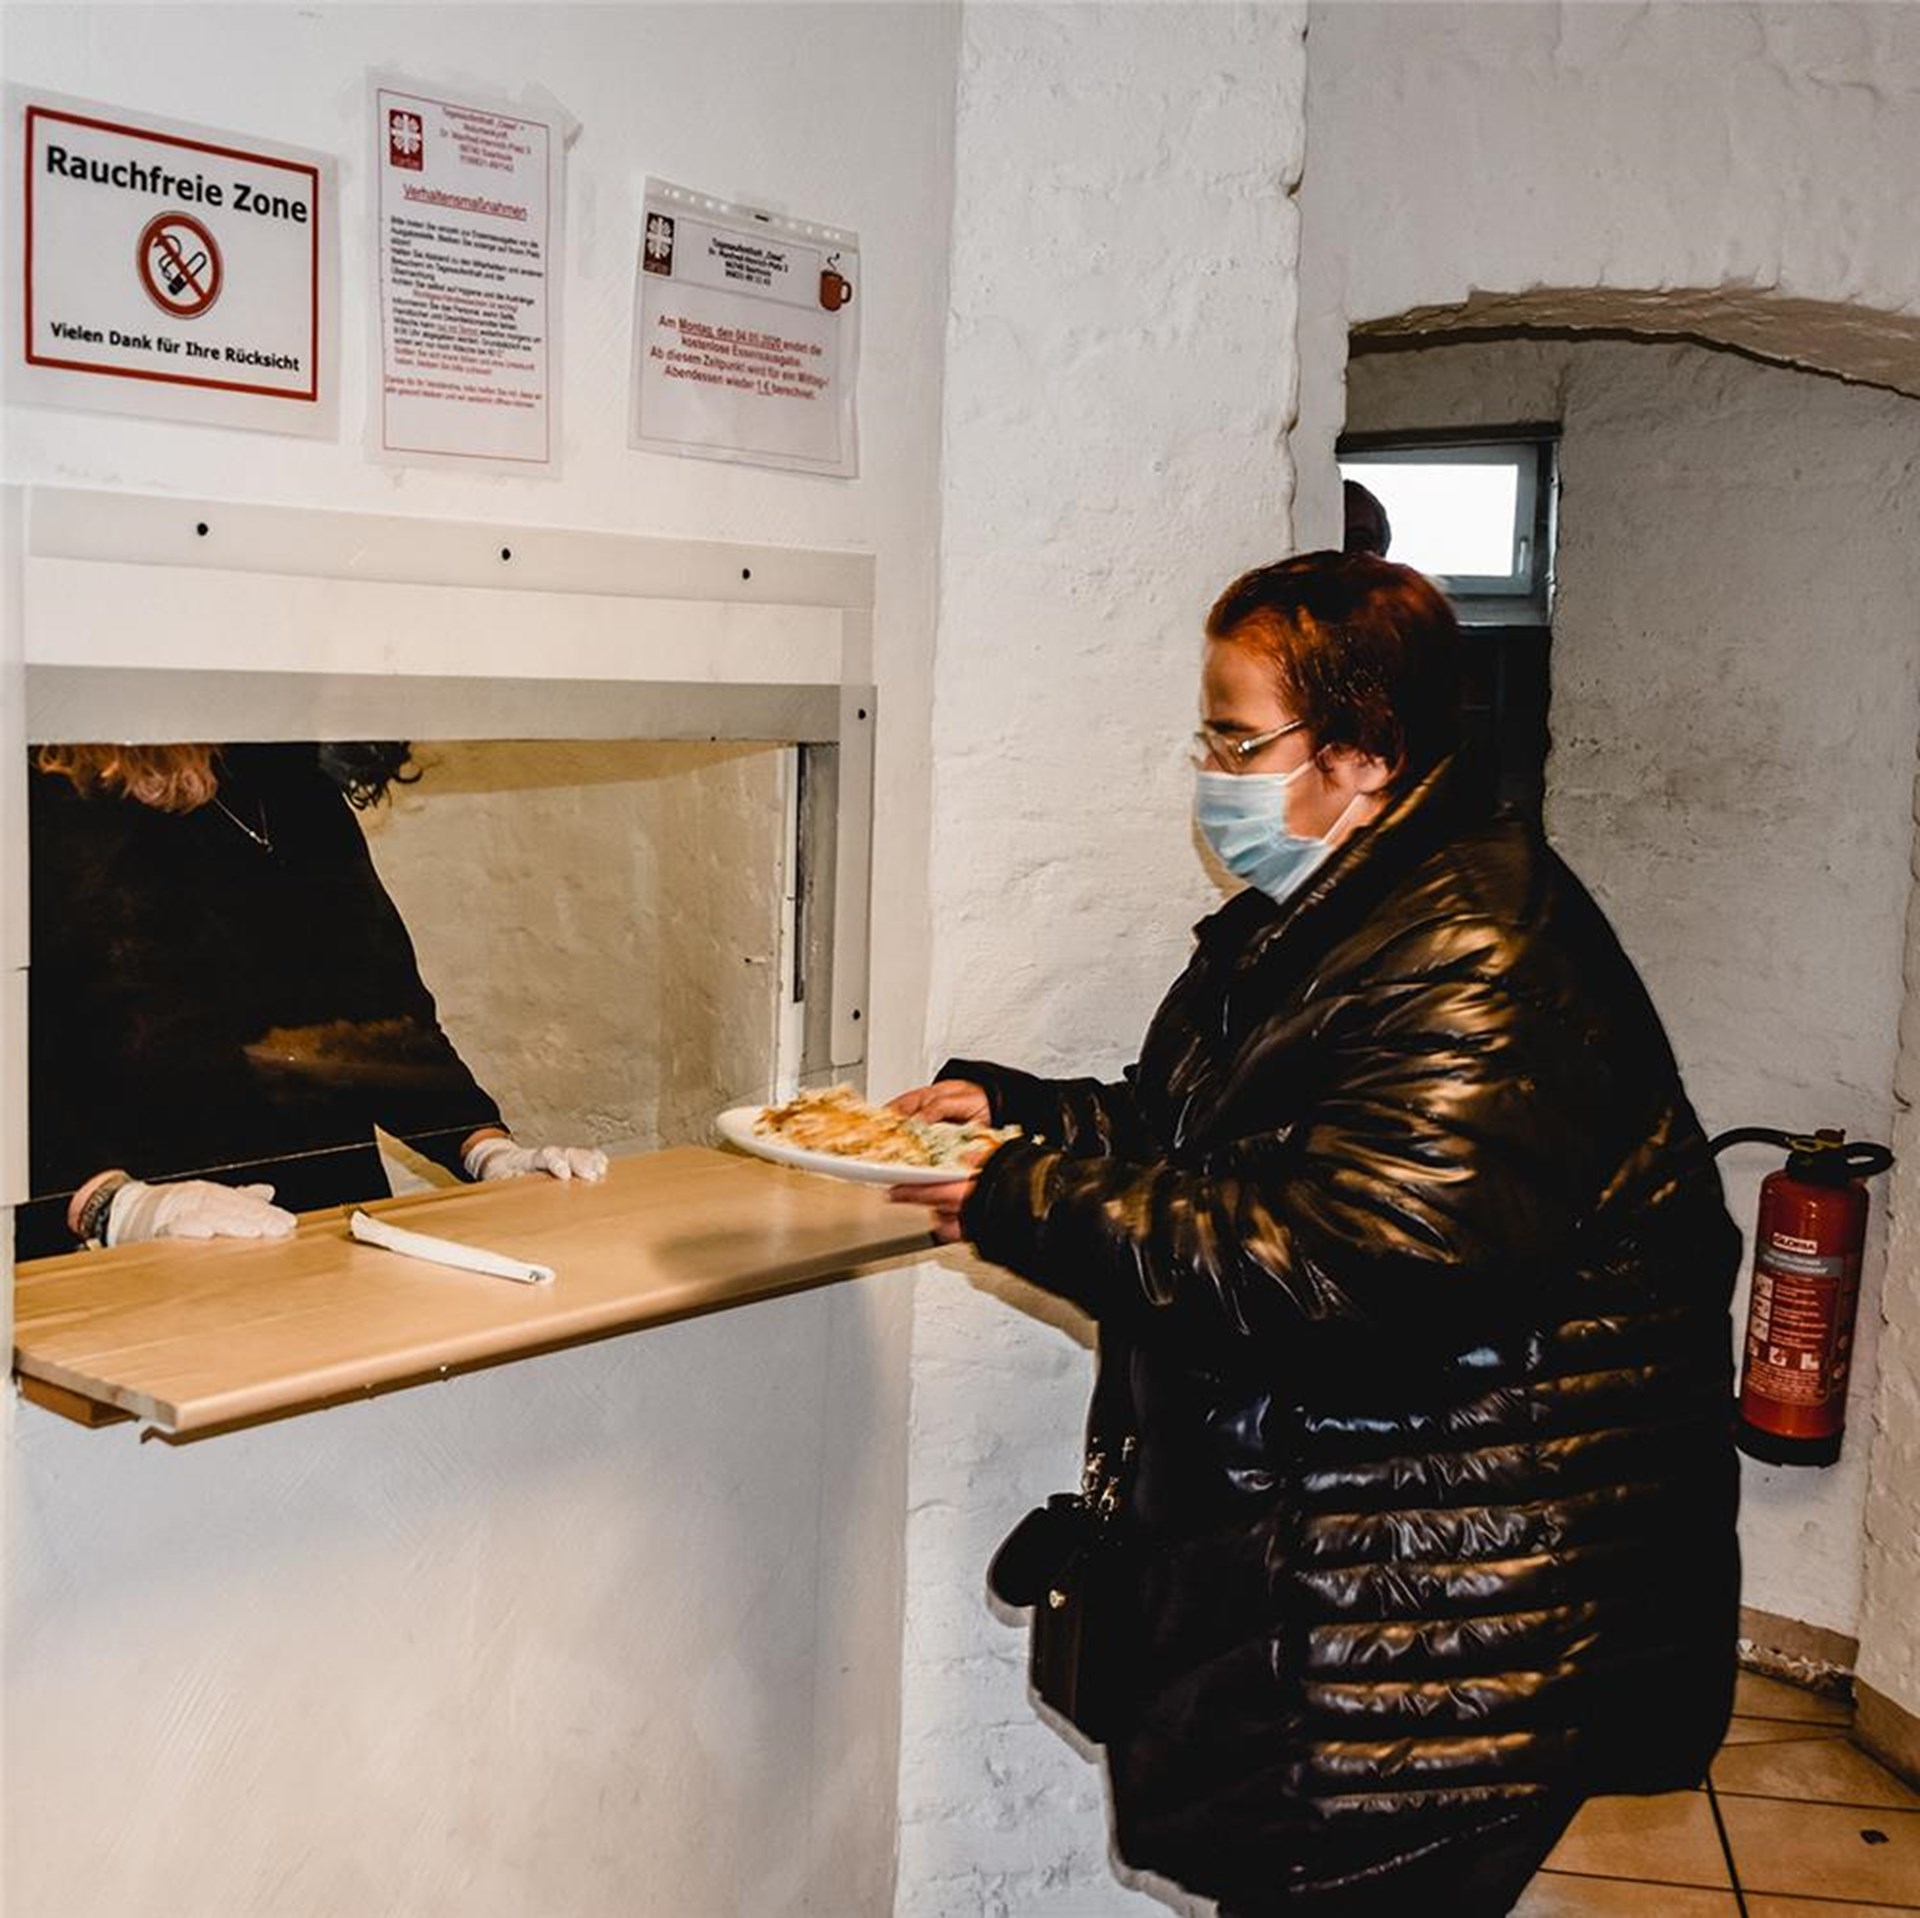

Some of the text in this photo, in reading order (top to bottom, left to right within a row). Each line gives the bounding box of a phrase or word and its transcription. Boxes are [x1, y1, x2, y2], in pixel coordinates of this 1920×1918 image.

[46, 145, 308, 223] Rauchfreie Zone
[403, 183, 527, 221] Verhaltensmaßnahmen
[658, 314, 675, 328] Am
[679, 318, 713, 338] Montag,
[717, 326, 732, 339] den
[51, 322, 299, 372] Vielen Dank für Ihre Rücksicht
[650, 345, 663, 358] Ab
[666, 348, 700, 365] diesem
[703, 354, 745, 374] Zeitpunkt
[681, 335, 729, 355] kostenlose
[665, 364, 722, 384] Abendessen
